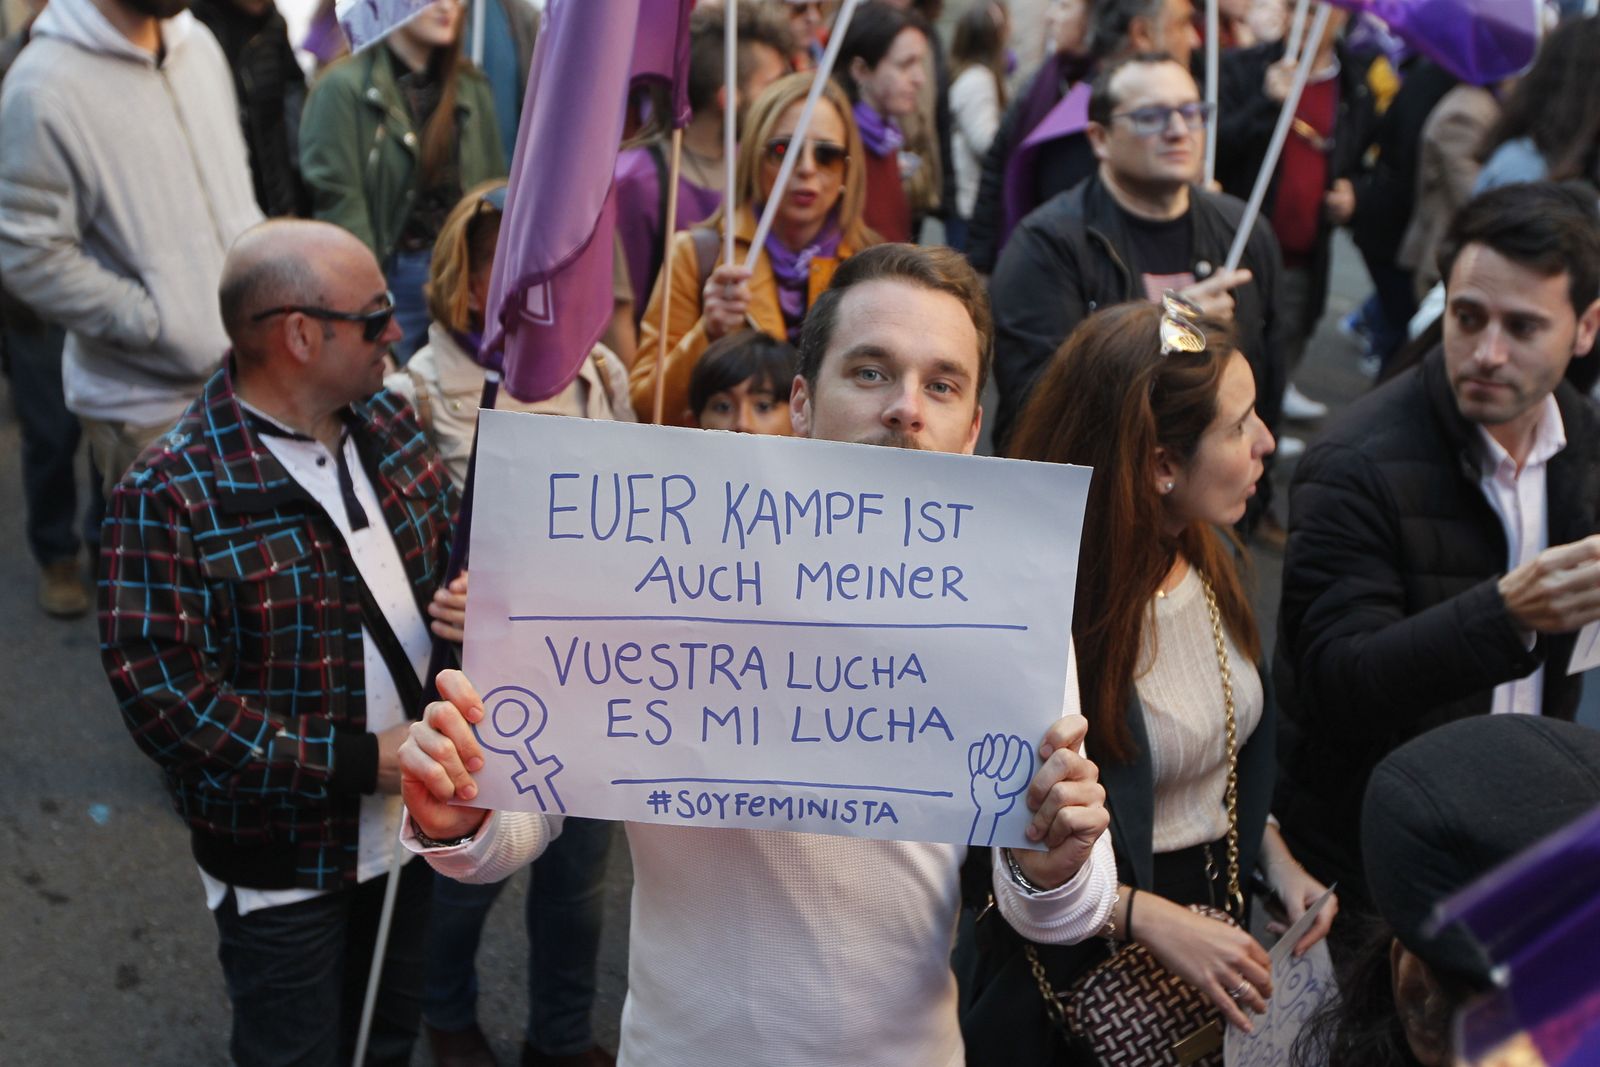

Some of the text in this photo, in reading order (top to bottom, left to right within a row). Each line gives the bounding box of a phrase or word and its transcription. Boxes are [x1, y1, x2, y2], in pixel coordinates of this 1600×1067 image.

[549, 473, 974, 549] EUER KAMPF IST
[635, 556, 762, 605] AUCH
[787, 652, 927, 692] LUCHA
[607, 699, 955, 746] ES MI LUCHA
